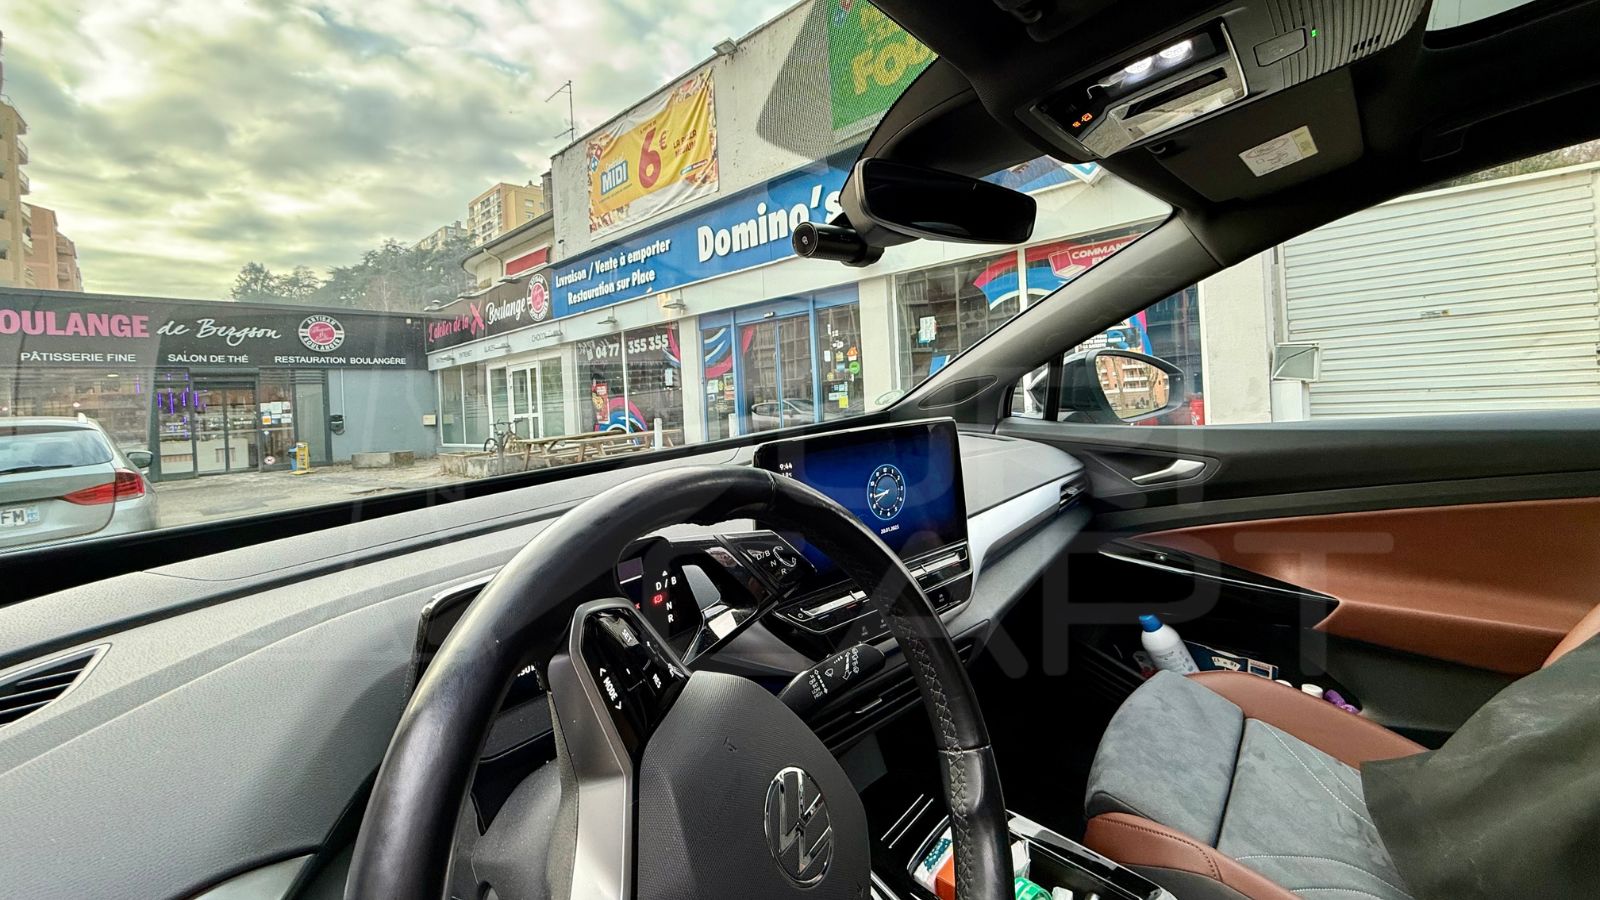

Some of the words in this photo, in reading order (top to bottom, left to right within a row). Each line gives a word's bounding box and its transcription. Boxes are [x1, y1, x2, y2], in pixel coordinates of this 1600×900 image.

[603, 161, 627, 194] MIDI
[595, 257, 619, 274] Vente
[620, 252, 627, 266] à
[627, 239, 671, 263] emporter
[568, 281, 615, 306] Restauration
[616, 277, 631, 291] sur
[631, 267, 656, 287] Place
[486, 297, 526, 325] Boulange
[157, 320, 190, 336] de
[196, 318, 281, 346] Bergson
[453, 315, 461, 333] de
[628, 338, 647, 354] 355
[648, 334, 669, 351] 355
[20, 351, 104, 362] PÂTISSERIE
[107, 353, 137, 362] FINE
[168, 353, 207, 362] SALON
[210, 355, 225, 363] DE
[227, 354, 249, 363] THÉ
[274, 355, 346, 364] RESTAURATION
[350, 357, 406, 365] BOULANGÈRE
[666, 601, 672, 610] N
[667, 613, 674, 623] R
[621, 629, 632, 643] SET
[603, 676, 618, 701] MODE
